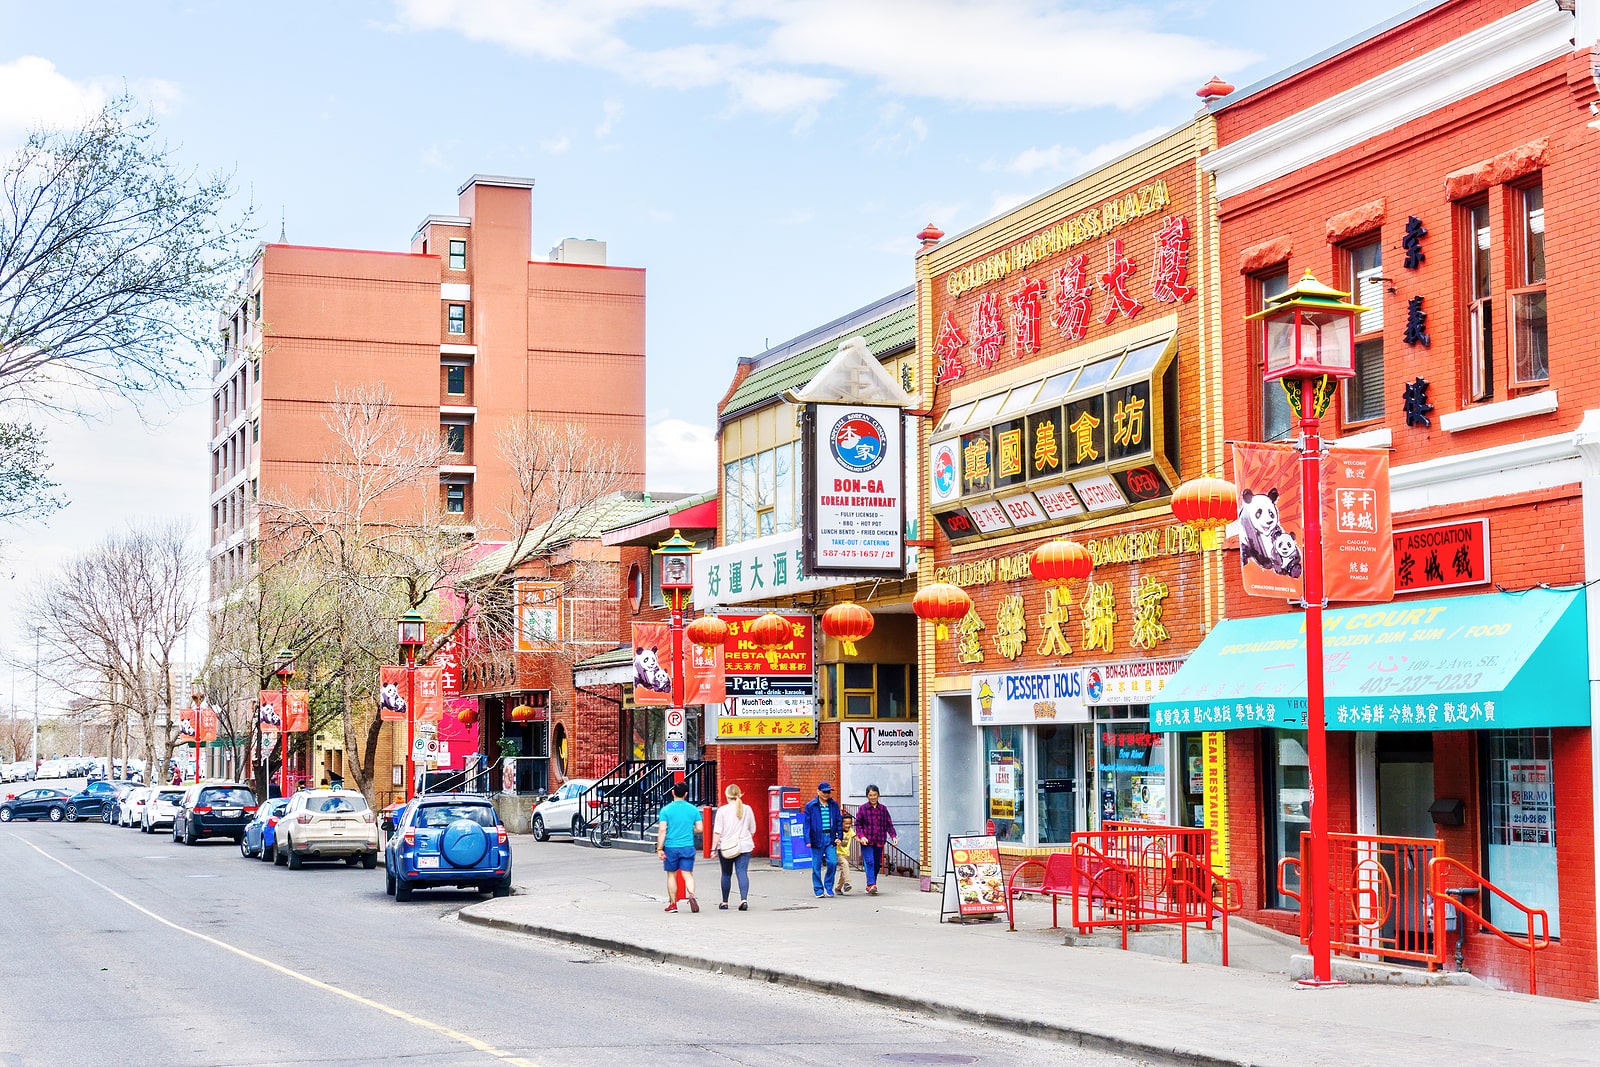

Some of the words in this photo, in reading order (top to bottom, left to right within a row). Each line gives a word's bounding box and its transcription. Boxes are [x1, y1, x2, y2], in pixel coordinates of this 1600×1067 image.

[946, 249, 1011, 298] GOLDEN
[1011, 207, 1103, 271] HAPPINESS
[1103, 179, 1171, 232] PLAZA
[964, 395, 1145, 488] 韓國美食坊
[1130, 476, 1157, 493] OPEN
[1345, 468, 1366, 479] 歡迎
[834, 479, 885, 493] BON-GA
[1080, 482, 1121, 507] CATERING
[821, 496, 849, 506] KOREAN
[851, 497, 896, 507] RESTAURANT
[1007, 501, 1037, 520] BBQ
[947, 515, 970, 531] OPEN
[1088, 529, 1161, 567] BAKERY
[1408, 528, 1472, 550] ASSOCIATION
[1345, 607, 1448, 630] COURT
[1218, 639, 1299, 656] SPECIALIZING
[1376, 631, 1407, 645] DIM
[1409, 628, 1446, 642] SUM
[1464, 624, 1513, 639] FOOD
[1105, 666, 1128, 679] BON-GA
[1129, 663, 1155, 678] KOREAN
[733, 676, 768, 690] Parlé
[1006, 675, 1050, 701] DESSERT
[1358, 672, 1483, 694] 403-237-0233
[1443, 700, 1496, 723] 歡迎外賣
[878, 729, 914, 737] MuchTech
[1209, 731, 1218, 763] REAN
[1209, 768, 1219, 855] RESTAURANT
